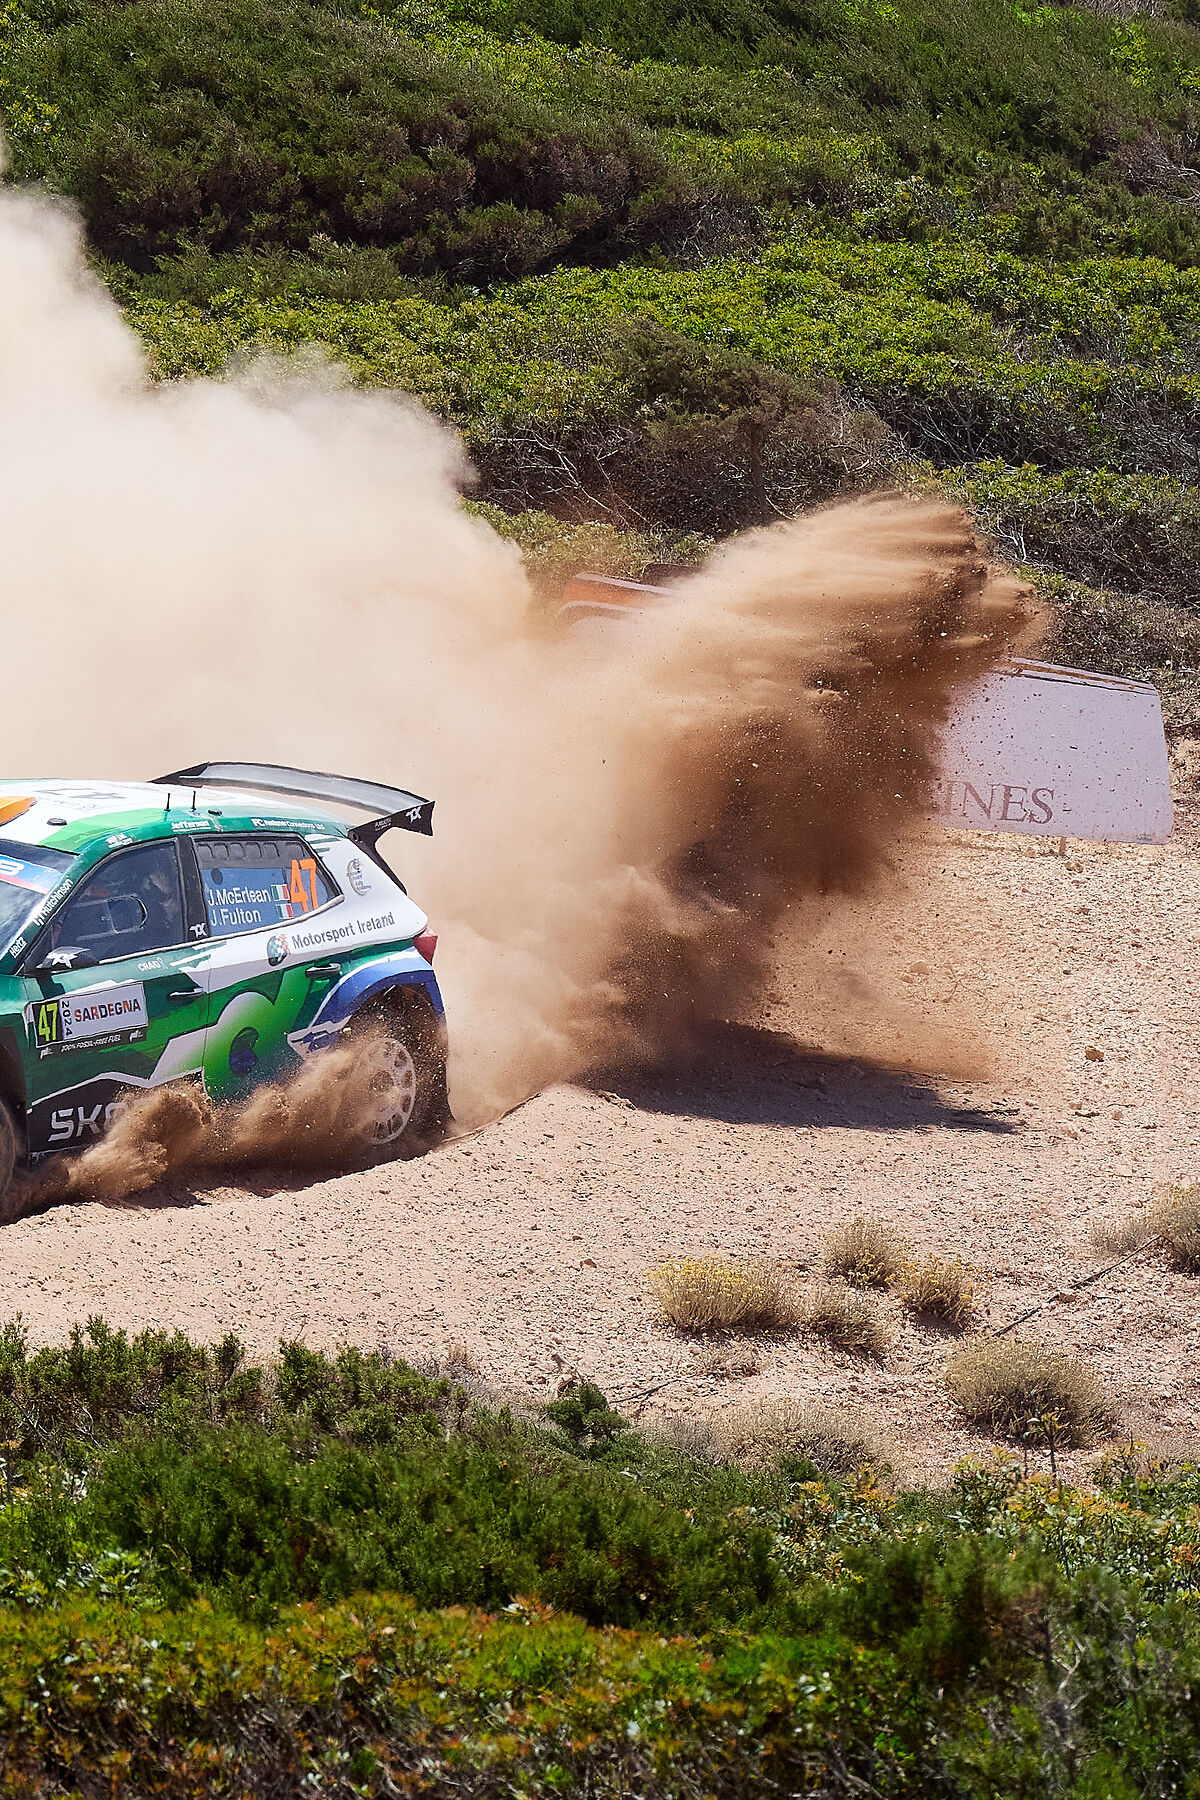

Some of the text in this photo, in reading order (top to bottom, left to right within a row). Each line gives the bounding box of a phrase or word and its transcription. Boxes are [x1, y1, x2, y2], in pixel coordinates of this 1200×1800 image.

[41, 878, 74, 917] Hutchinson
[207, 887, 271, 907] J.McErlean
[290, 858, 318, 912] 47
[210, 908, 261, 927] J.Fulton
[291, 911, 395, 949] Motorsport Ireland
[38, 1002, 58, 1042] 47
[61, 1000, 74, 1037] 2024
[73, 998, 142, 1023] SARDEGNA
